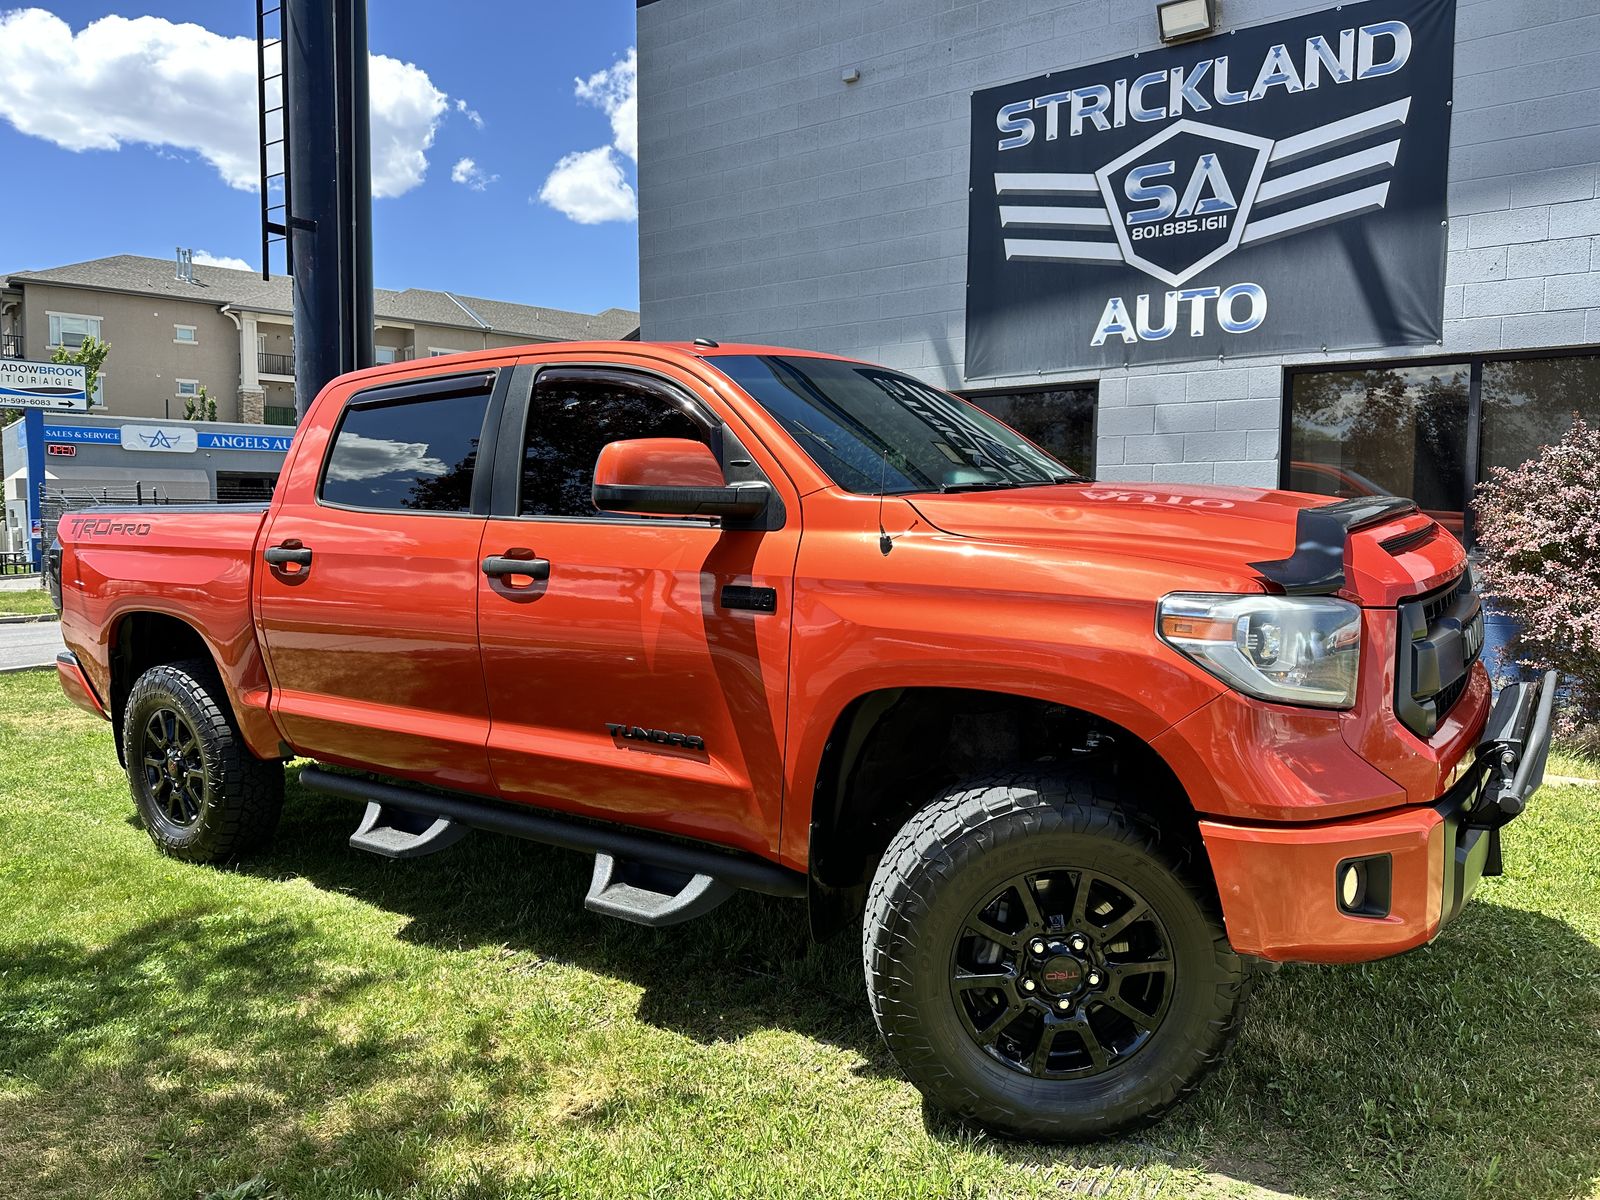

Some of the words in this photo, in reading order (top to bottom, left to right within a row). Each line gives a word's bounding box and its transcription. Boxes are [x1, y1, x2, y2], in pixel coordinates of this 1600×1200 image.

[996, 20, 1413, 151] STRICKLAND
[1124, 152, 1238, 226] SA
[1131, 215, 1227, 241] 801.885.1611
[1089, 282, 1268, 347] AUTO
[45, 430, 73, 438] SALES
[83, 431, 120, 440] SERVICE
[210, 436, 270, 449] ANGELS
[49, 445, 75, 456] OPEN
[604, 722, 705, 751] TUNDRA
